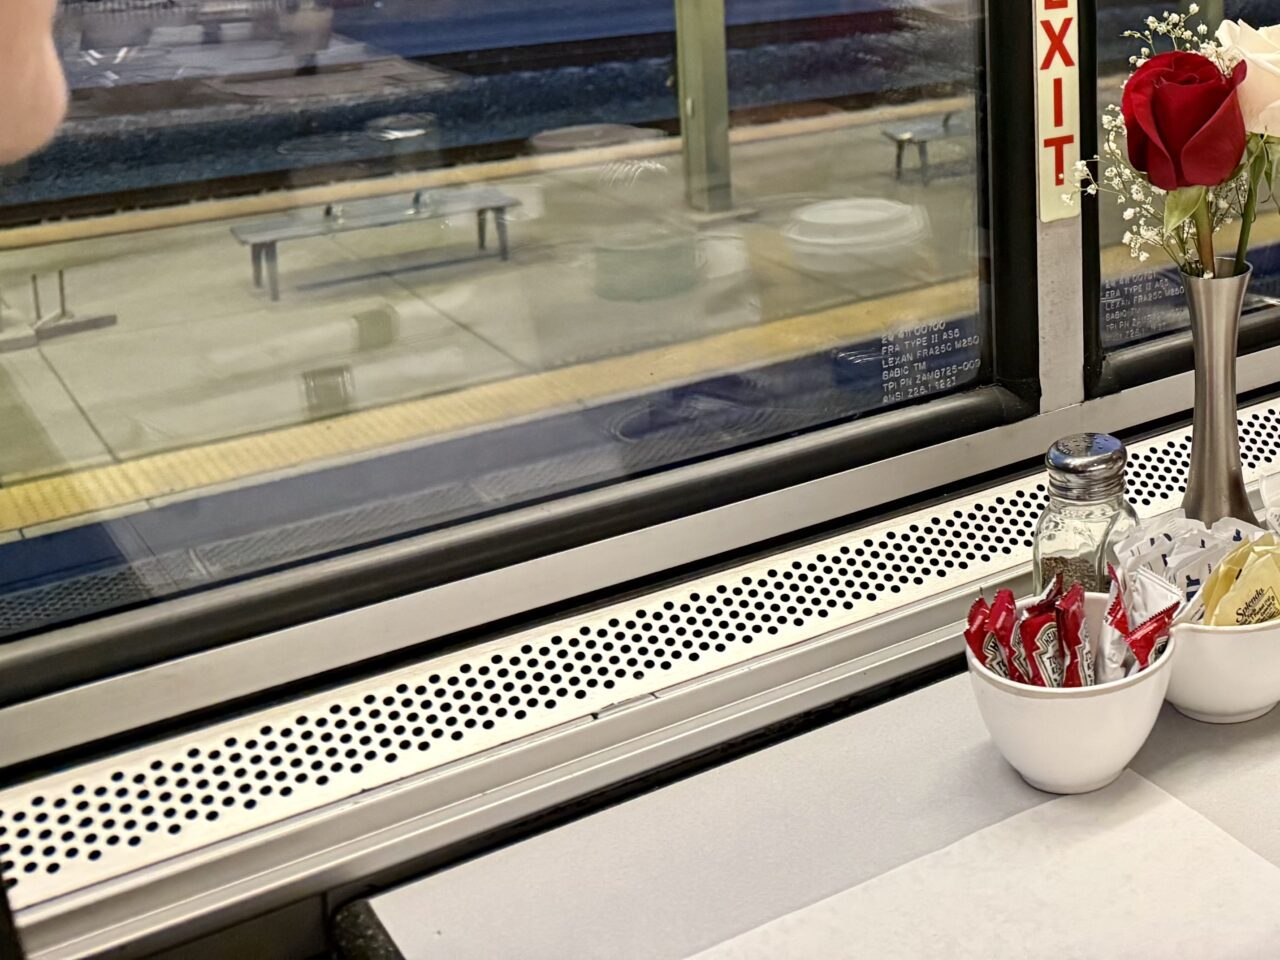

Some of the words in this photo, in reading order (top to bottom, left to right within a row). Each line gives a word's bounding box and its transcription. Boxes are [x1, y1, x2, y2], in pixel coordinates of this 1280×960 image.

[881, 344, 900, 355] FRA
[904, 336, 928, 349] TYPE
[881, 353, 913, 368] LEXAN
[913, 361, 927, 371] TM
[882, 381, 897, 392] TPI
[1236, 587, 1266, 624] Splenda
